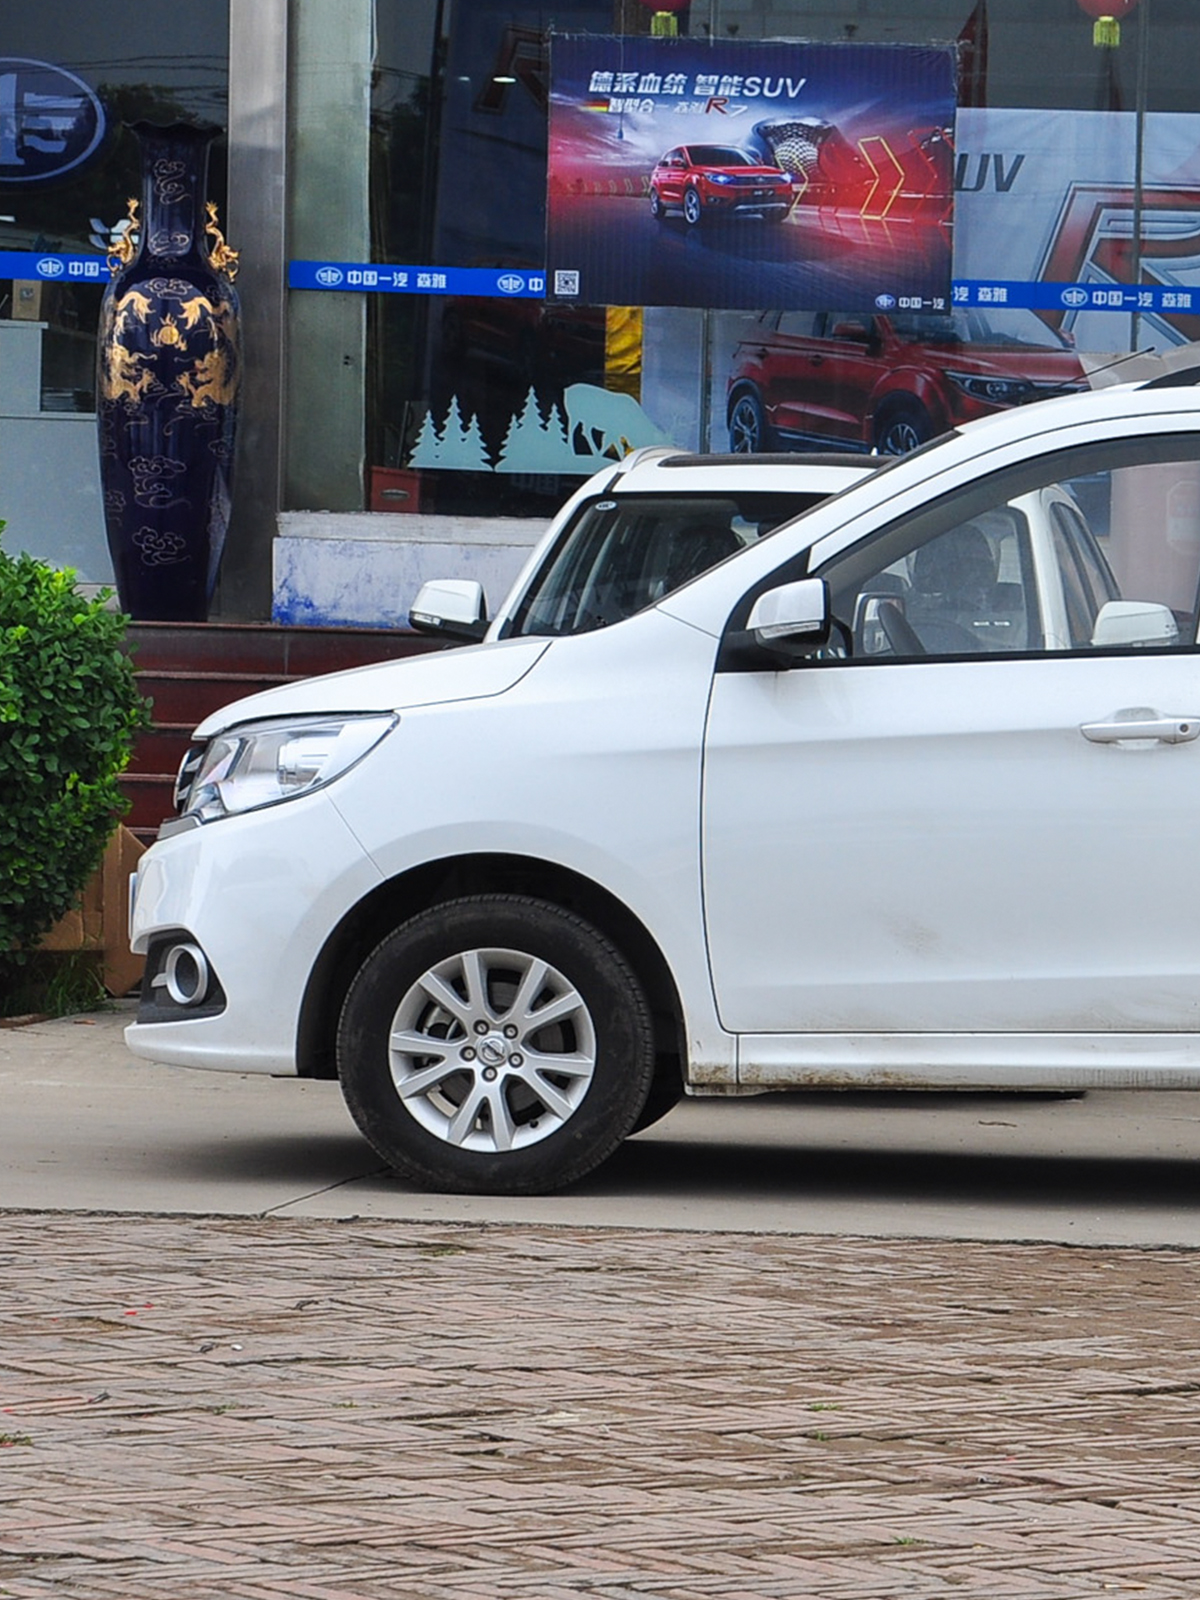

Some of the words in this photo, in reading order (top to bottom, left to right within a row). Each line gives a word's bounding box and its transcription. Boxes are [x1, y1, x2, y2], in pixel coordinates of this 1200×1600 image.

[588, 71, 688, 95] 德系血统
[693, 74, 807, 98] 智能SUV
[347, 270, 408, 288] 中国一汽
[416, 272, 447, 289] 森雅
[528, 277, 544, 292] 中
[898, 296, 945, 310] 中国一汽
[977, 286, 1008, 303] 森雅
[1092, 290, 1153, 308] 中国一汽
[1161, 292, 1192, 309] 森雅
